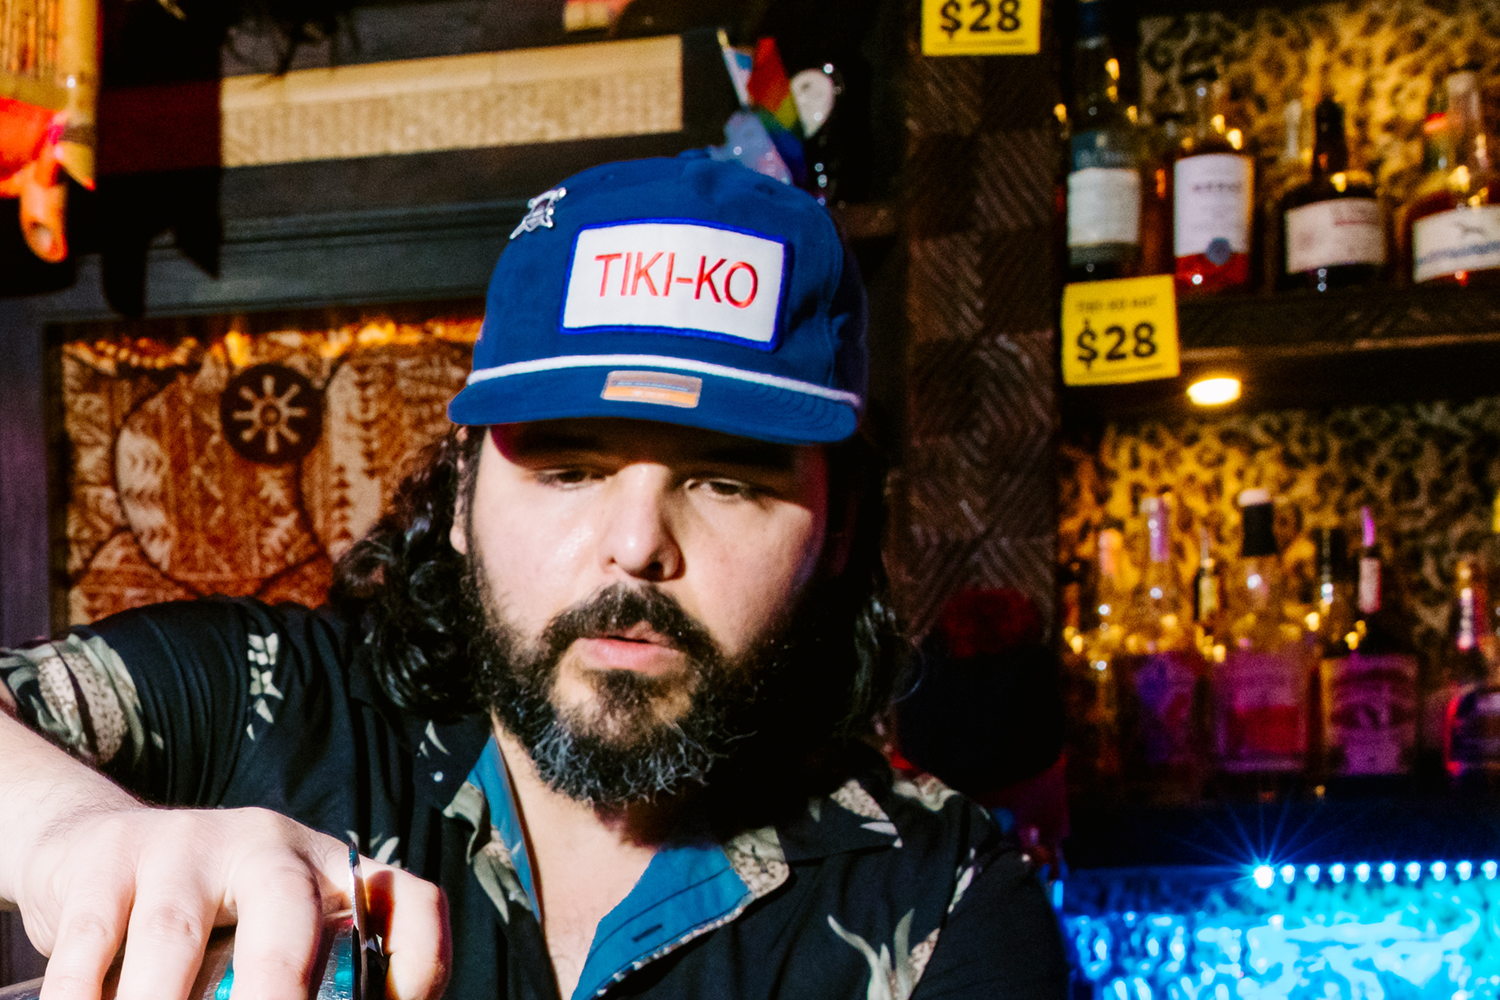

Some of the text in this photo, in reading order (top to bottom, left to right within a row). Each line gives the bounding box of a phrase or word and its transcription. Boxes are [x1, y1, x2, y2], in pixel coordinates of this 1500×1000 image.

[940, 0, 1020, 38] $28
[594, 251, 758, 309] TIKI-KO
[1077, 319, 1158, 370] $28
